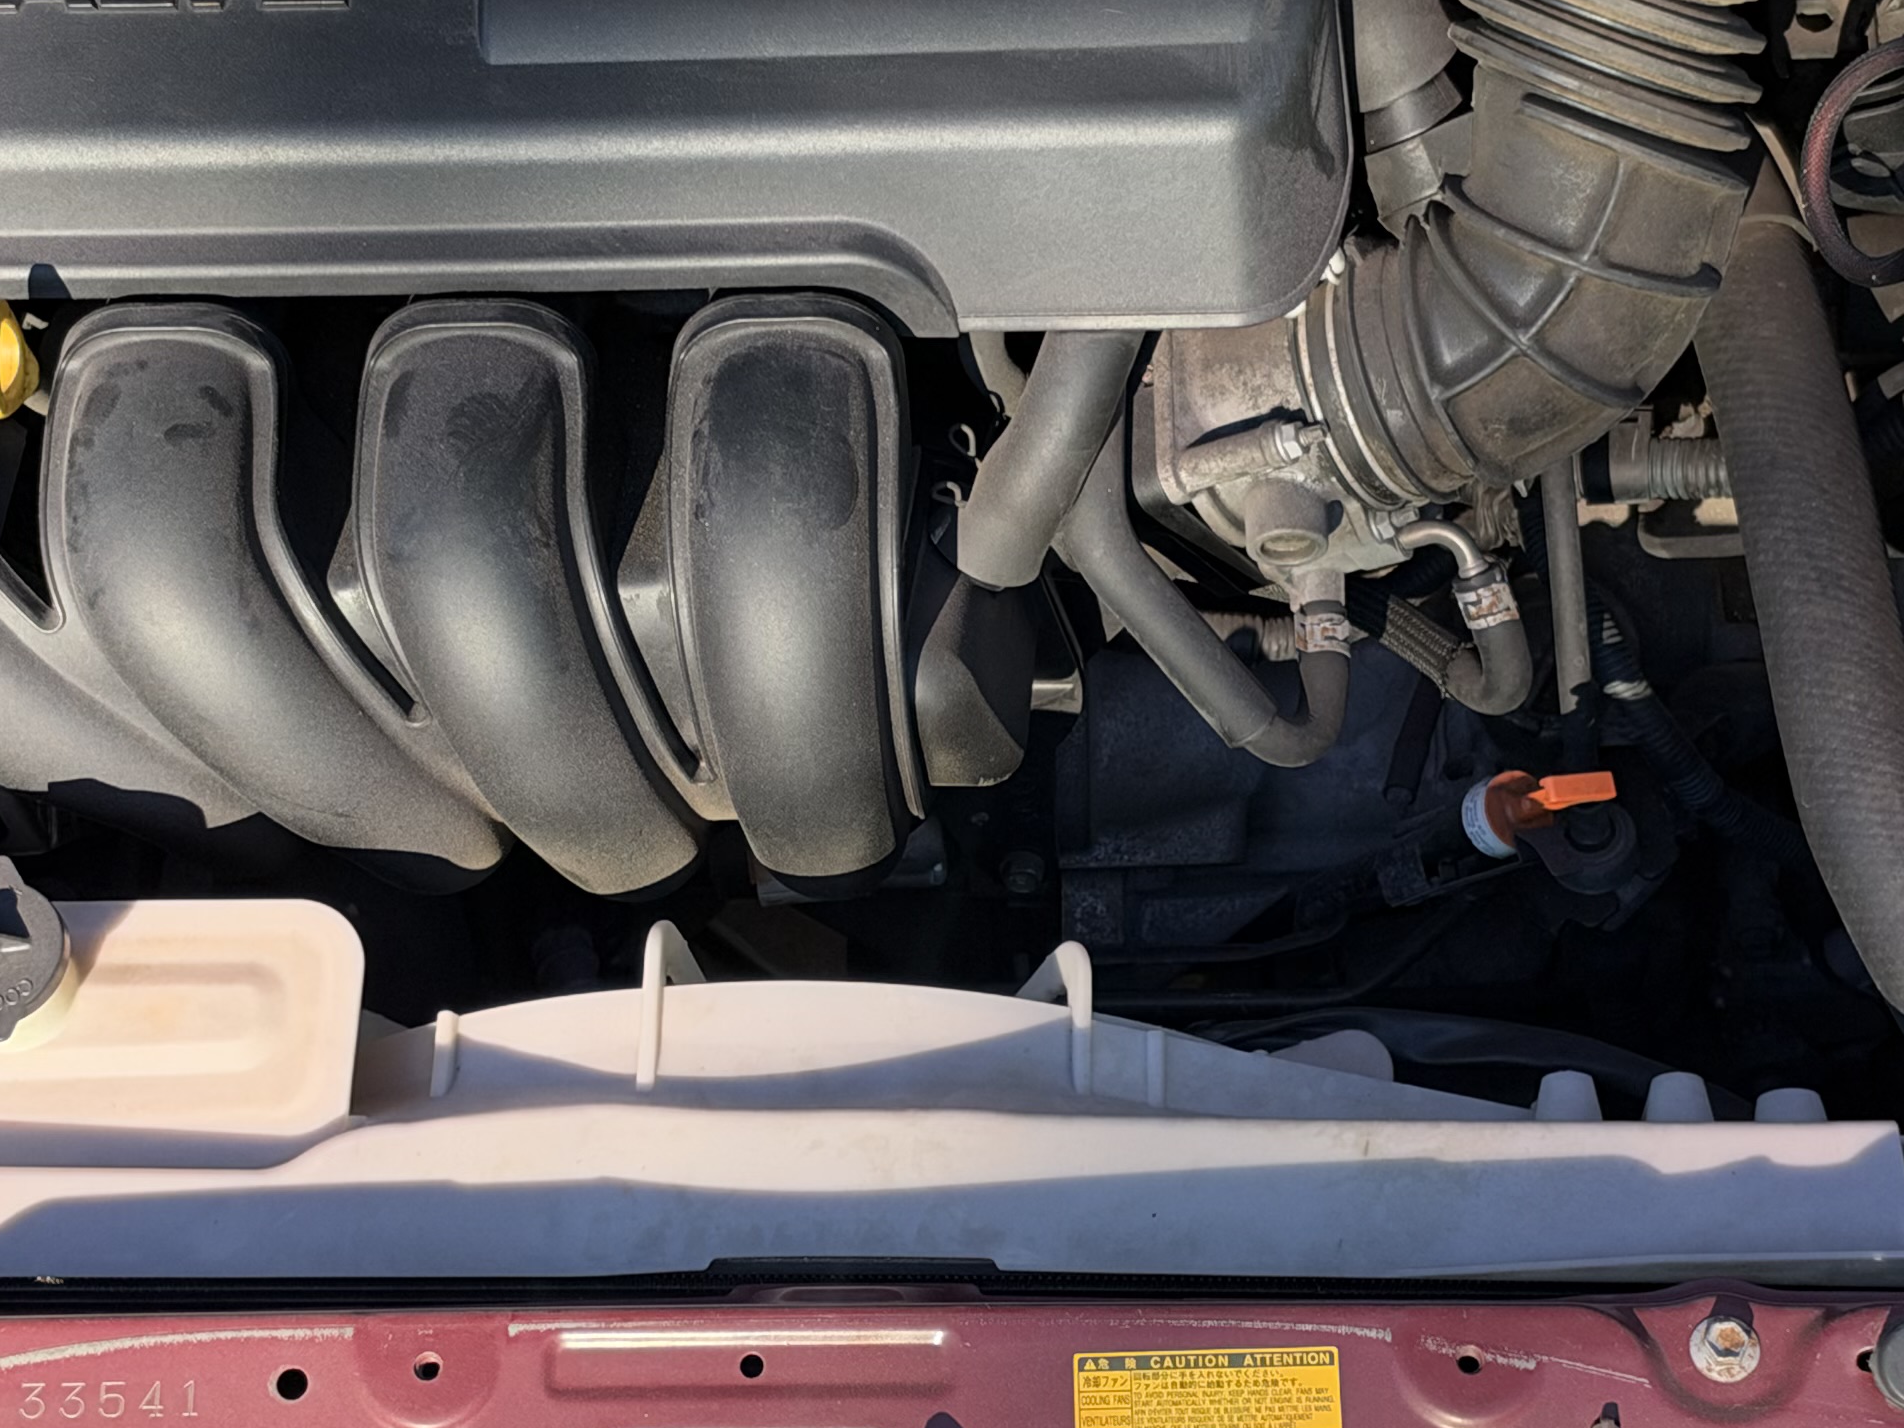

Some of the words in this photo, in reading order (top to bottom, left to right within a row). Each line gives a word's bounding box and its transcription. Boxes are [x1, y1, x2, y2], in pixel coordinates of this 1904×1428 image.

[1150, 1355, 1229, 1368] CAUTION
[1243, 1353, 1330, 1366] ATTENTION
[1082, 1375, 1128, 1388] 冷却ファン
[17, 1379, 200, 1420] 33541
[1081, 1394, 1111, 1405] COOLING
[1113, 1394, 1130, 1405] FANS
[1082, 1414, 1131, 1427] VENTILATEURS
